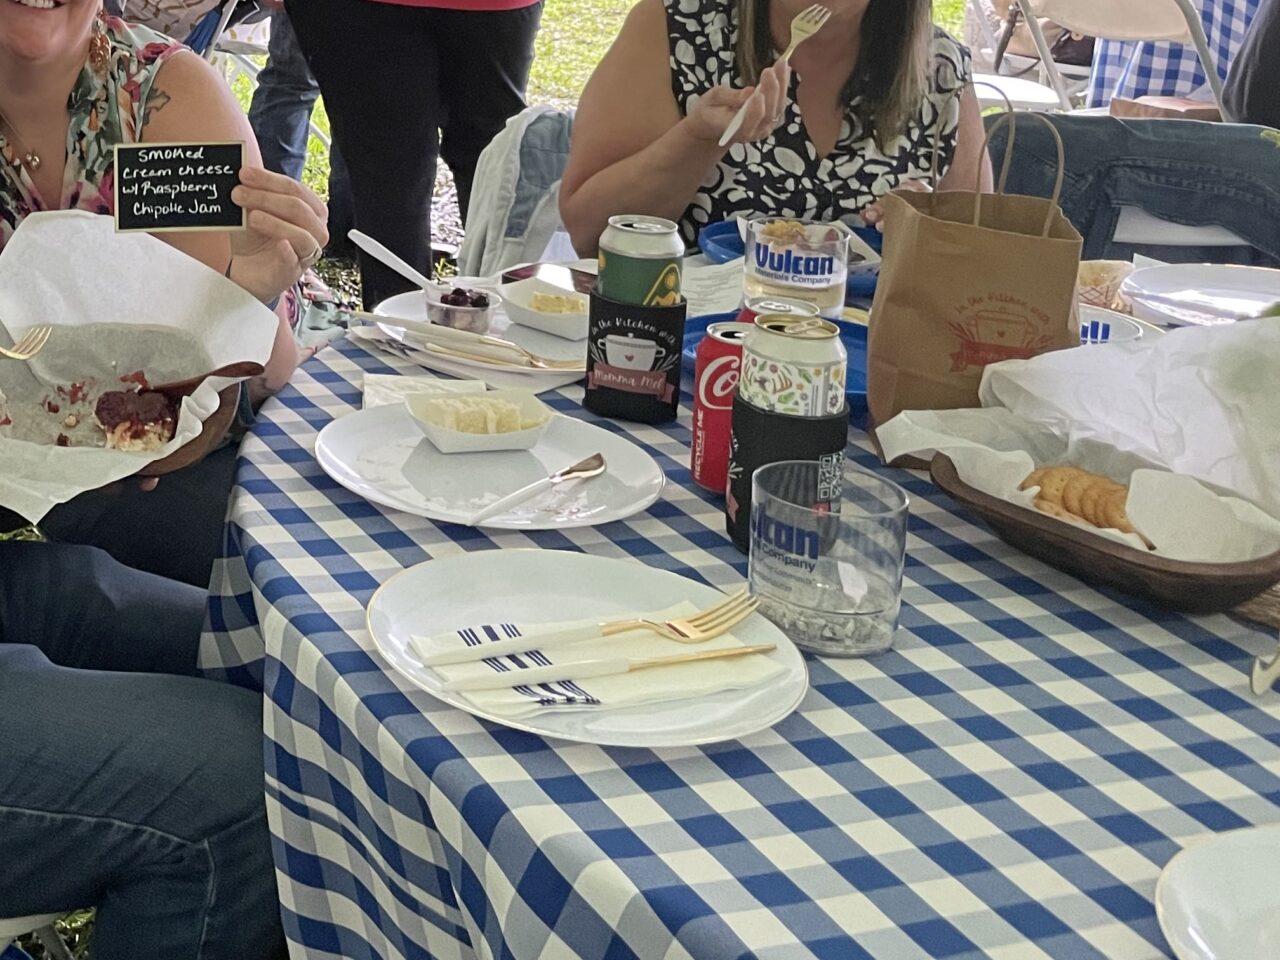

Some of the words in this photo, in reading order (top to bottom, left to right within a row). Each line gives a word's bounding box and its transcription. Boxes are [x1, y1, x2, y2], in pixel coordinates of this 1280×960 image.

[141, 181, 218, 200] Raspberry
[188, 198, 221, 214] Jam
[755, 242, 834, 276] Vulcan
[791, 275, 832, 285] Company
[761, 541, 816, 573] Company
